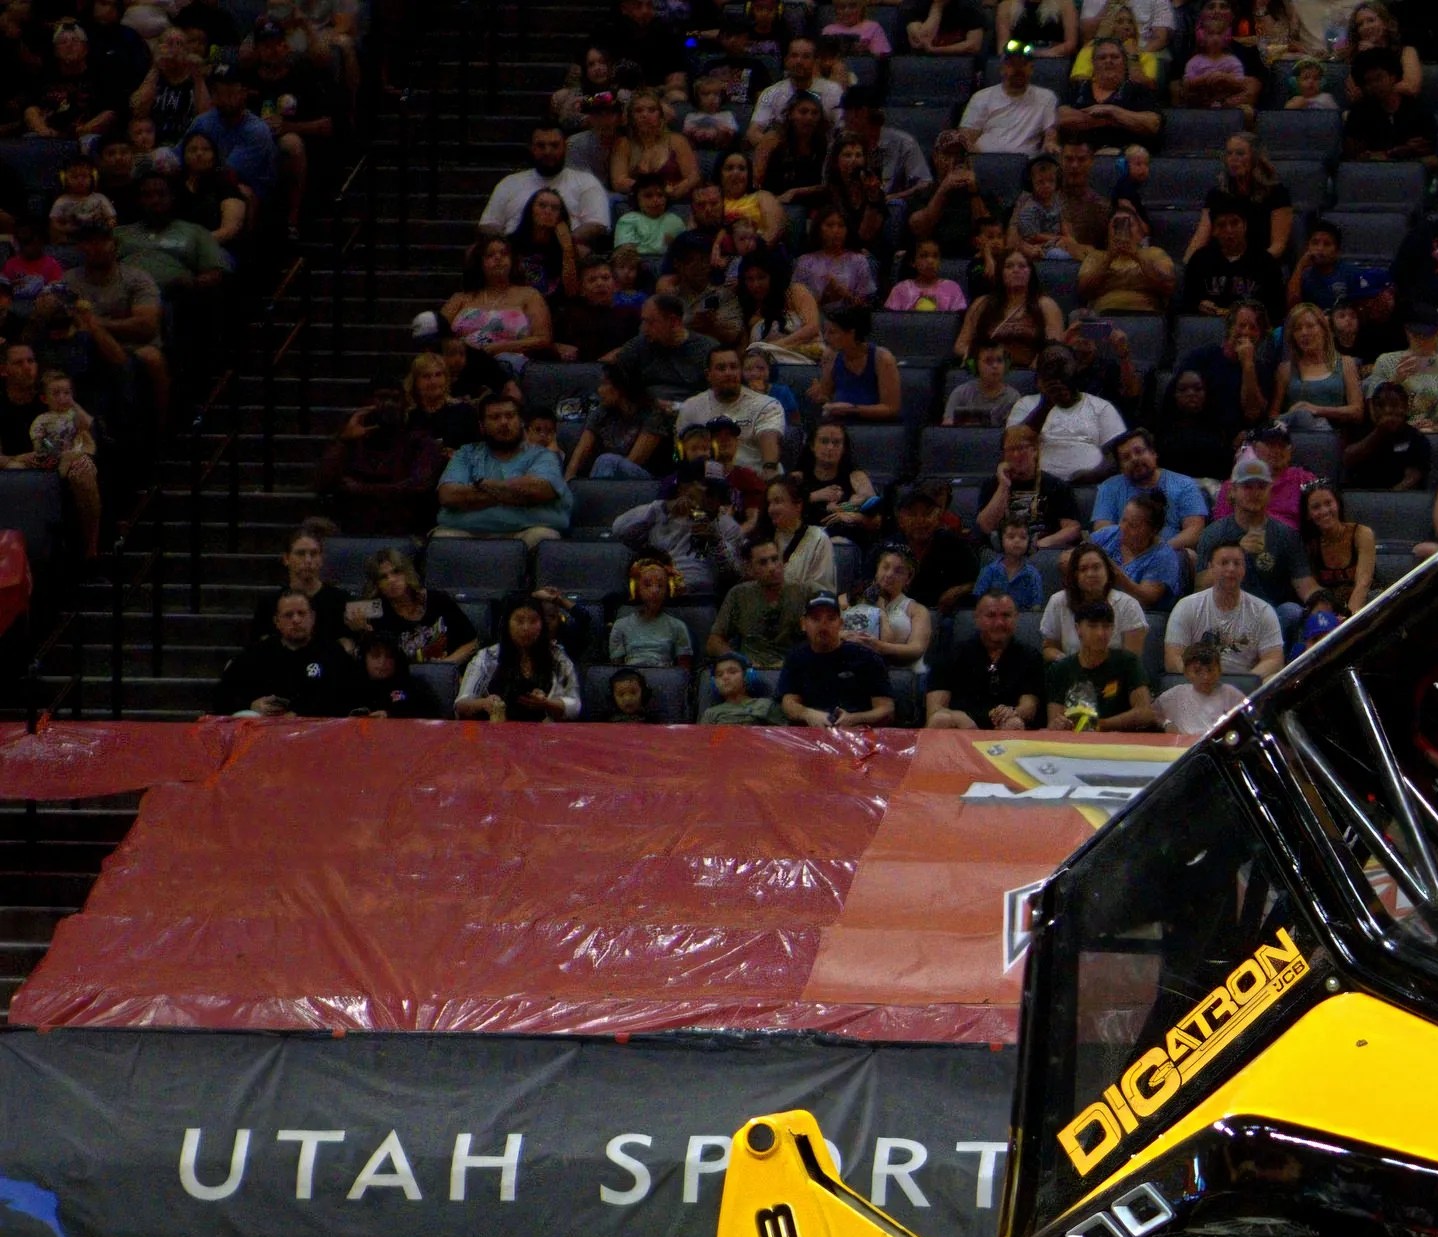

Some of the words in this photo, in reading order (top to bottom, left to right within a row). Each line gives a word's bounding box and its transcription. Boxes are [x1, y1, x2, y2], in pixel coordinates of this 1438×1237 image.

[1272, 962, 1306, 993] JCB
[1057, 927, 1301, 1177] DIGATRON
[179, 1128, 525, 1201] UTAH
[601, 1133, 1010, 1208] SPRT
